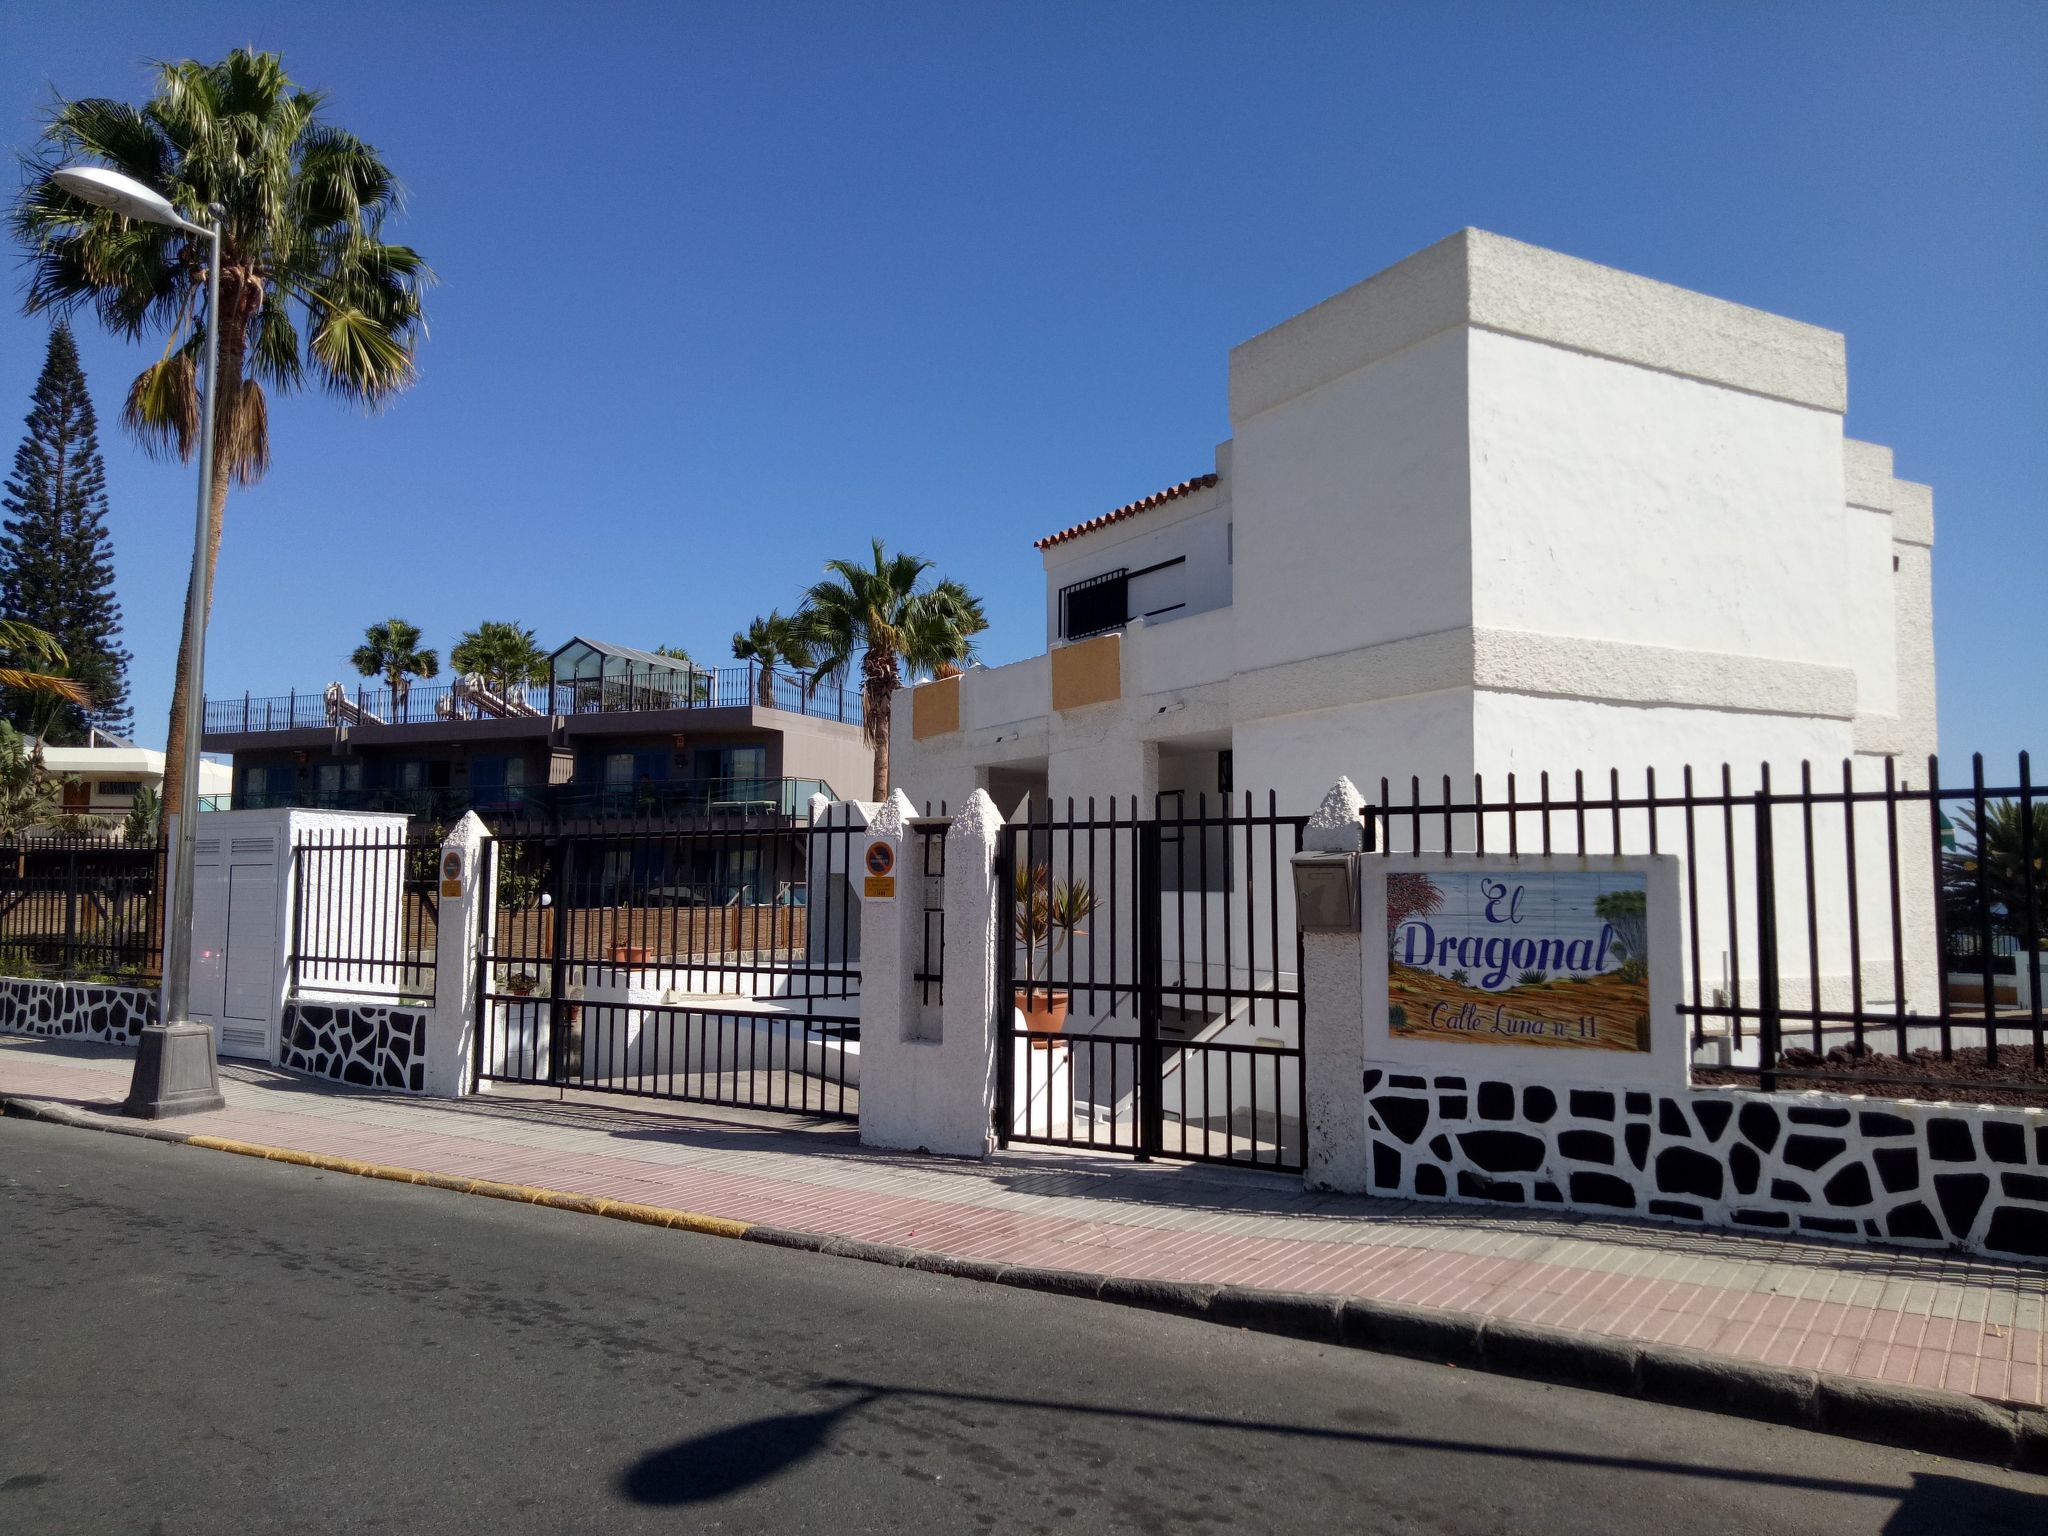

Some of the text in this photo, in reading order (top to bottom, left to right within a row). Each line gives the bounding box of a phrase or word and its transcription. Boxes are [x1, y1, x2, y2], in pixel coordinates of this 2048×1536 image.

[1481, 878, 1525, 924] El
[1400, 921, 1614, 989] Dragonal
[1430, 1001, 1481, 1031] Calle
[1490, 1004, 1545, 1037] Luna
[1578, 1015, 1596, 1037] 11
